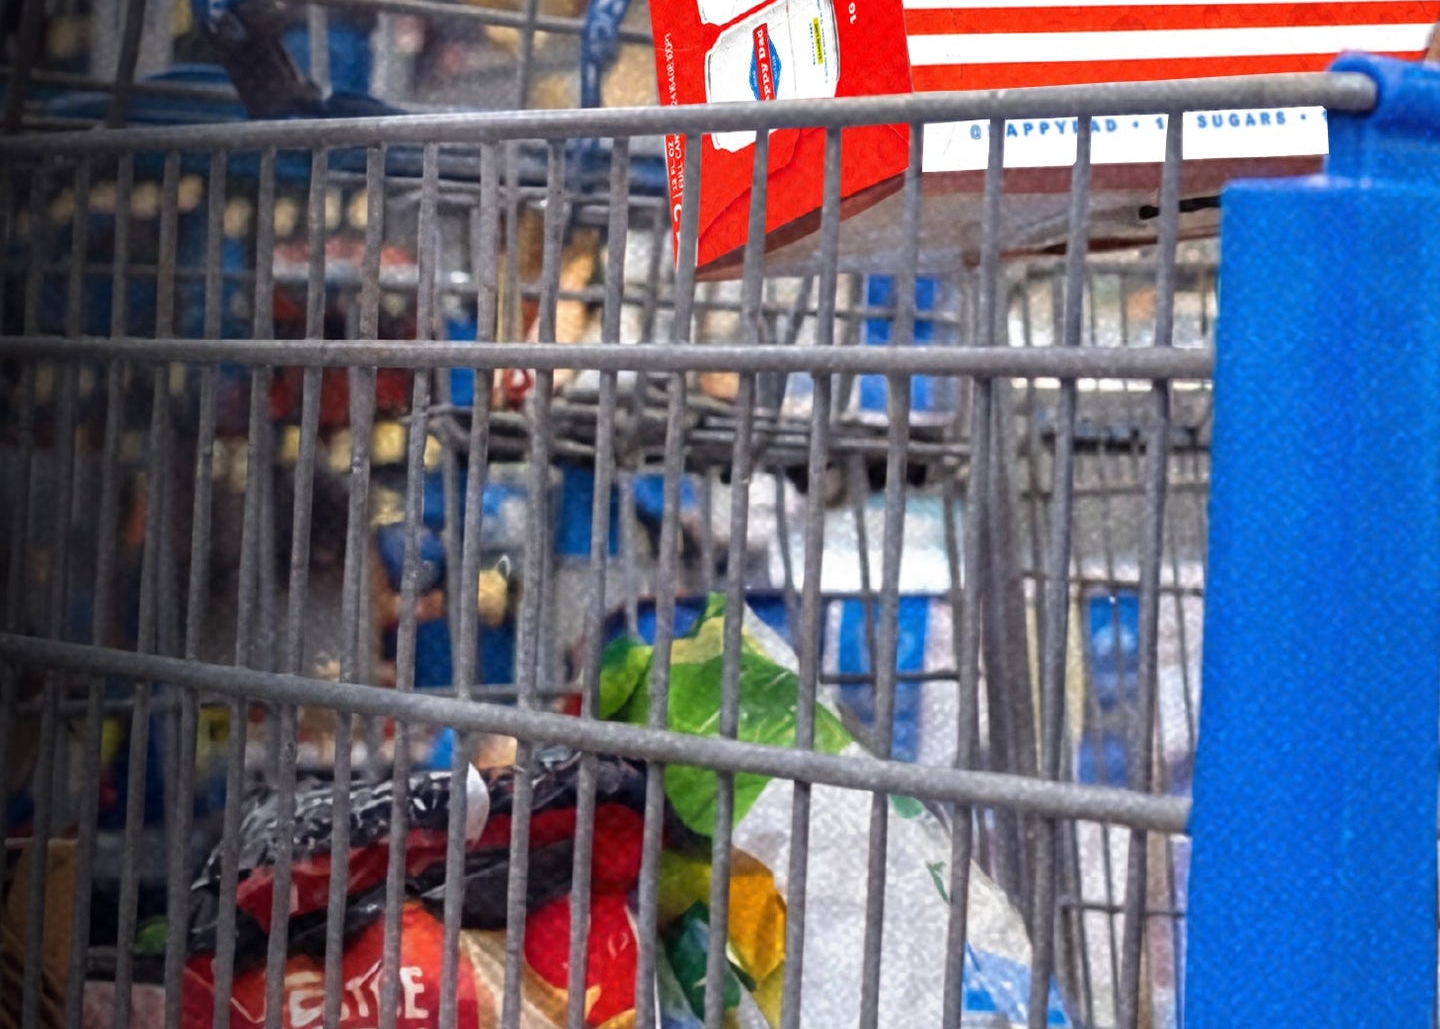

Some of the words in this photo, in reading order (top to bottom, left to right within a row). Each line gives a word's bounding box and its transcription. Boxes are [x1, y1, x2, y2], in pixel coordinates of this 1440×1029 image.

[757, 28, 766, 59] Dad
[970, 118, 1118, 140] @APPYAD
[1196, 111, 1287, 129] SUGARS
